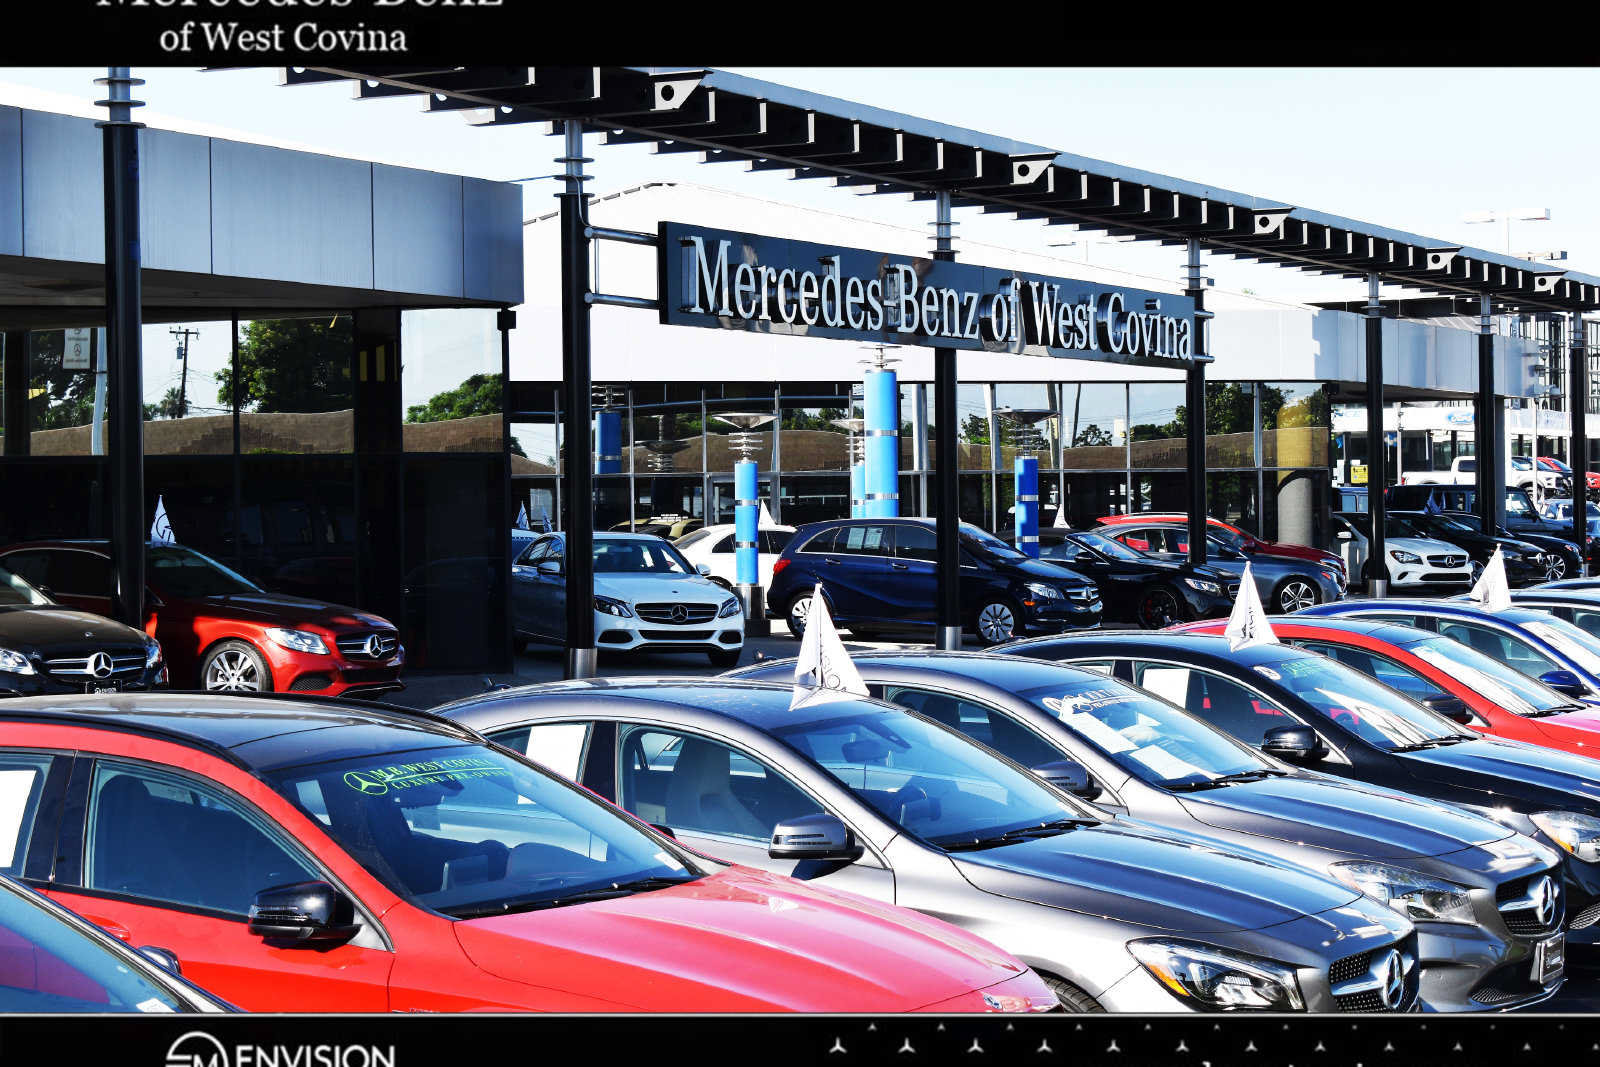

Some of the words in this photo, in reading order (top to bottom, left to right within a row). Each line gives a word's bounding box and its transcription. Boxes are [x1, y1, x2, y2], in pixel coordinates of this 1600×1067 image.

[690, 235, 980, 340] Mercedes-Benz
[991, 277, 1019, 342] of
[1030, 280, 1098, 351] West
[1107, 292, 1192, 361] Covina
